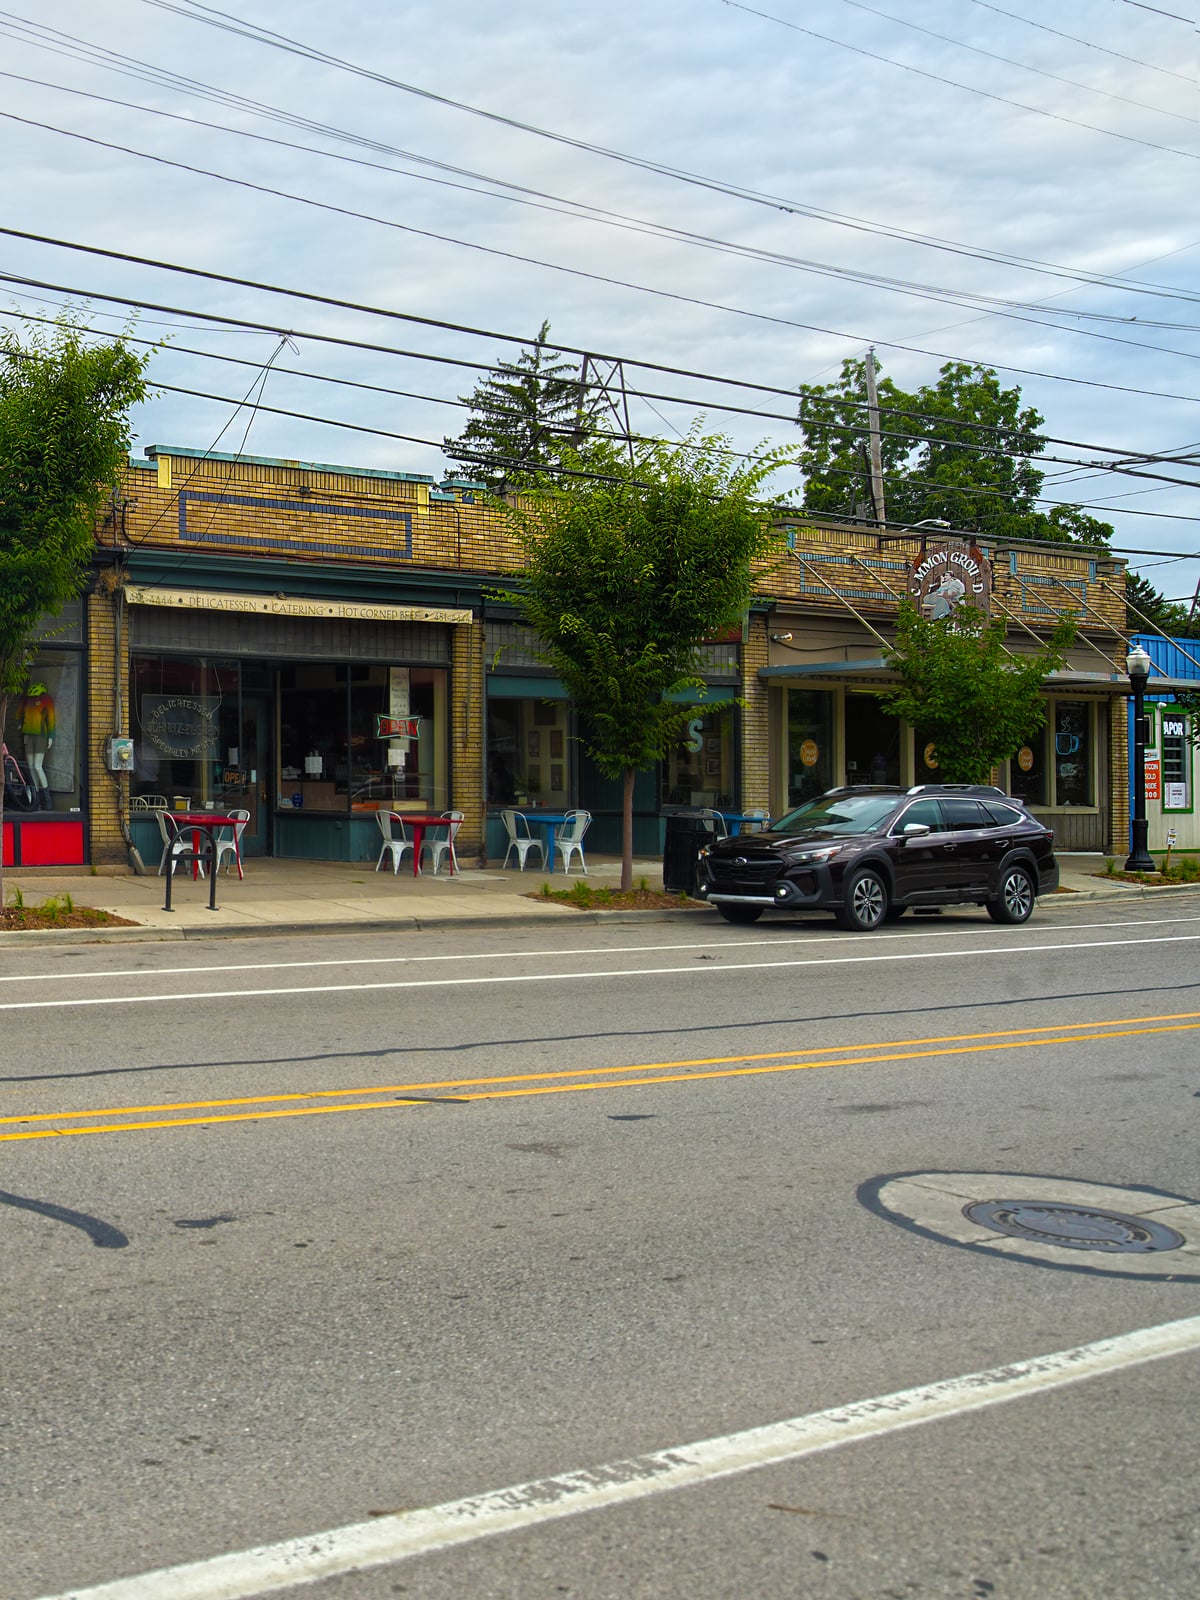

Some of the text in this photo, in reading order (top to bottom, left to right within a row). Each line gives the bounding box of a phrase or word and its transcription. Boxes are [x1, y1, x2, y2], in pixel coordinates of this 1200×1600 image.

[911, 551, 984, 597] CMMON GROUD
[189, 596, 257, 612] DELICATESSEN
[271, 602, 324, 616] CATERING
[338, 604, 359, 617] HOT
[360, 607, 398, 620] CORNED
[400, 610, 421, 620] BEEF
[380, 719, 418, 737] OPEN
[1163, 721, 1184, 735] APOR
